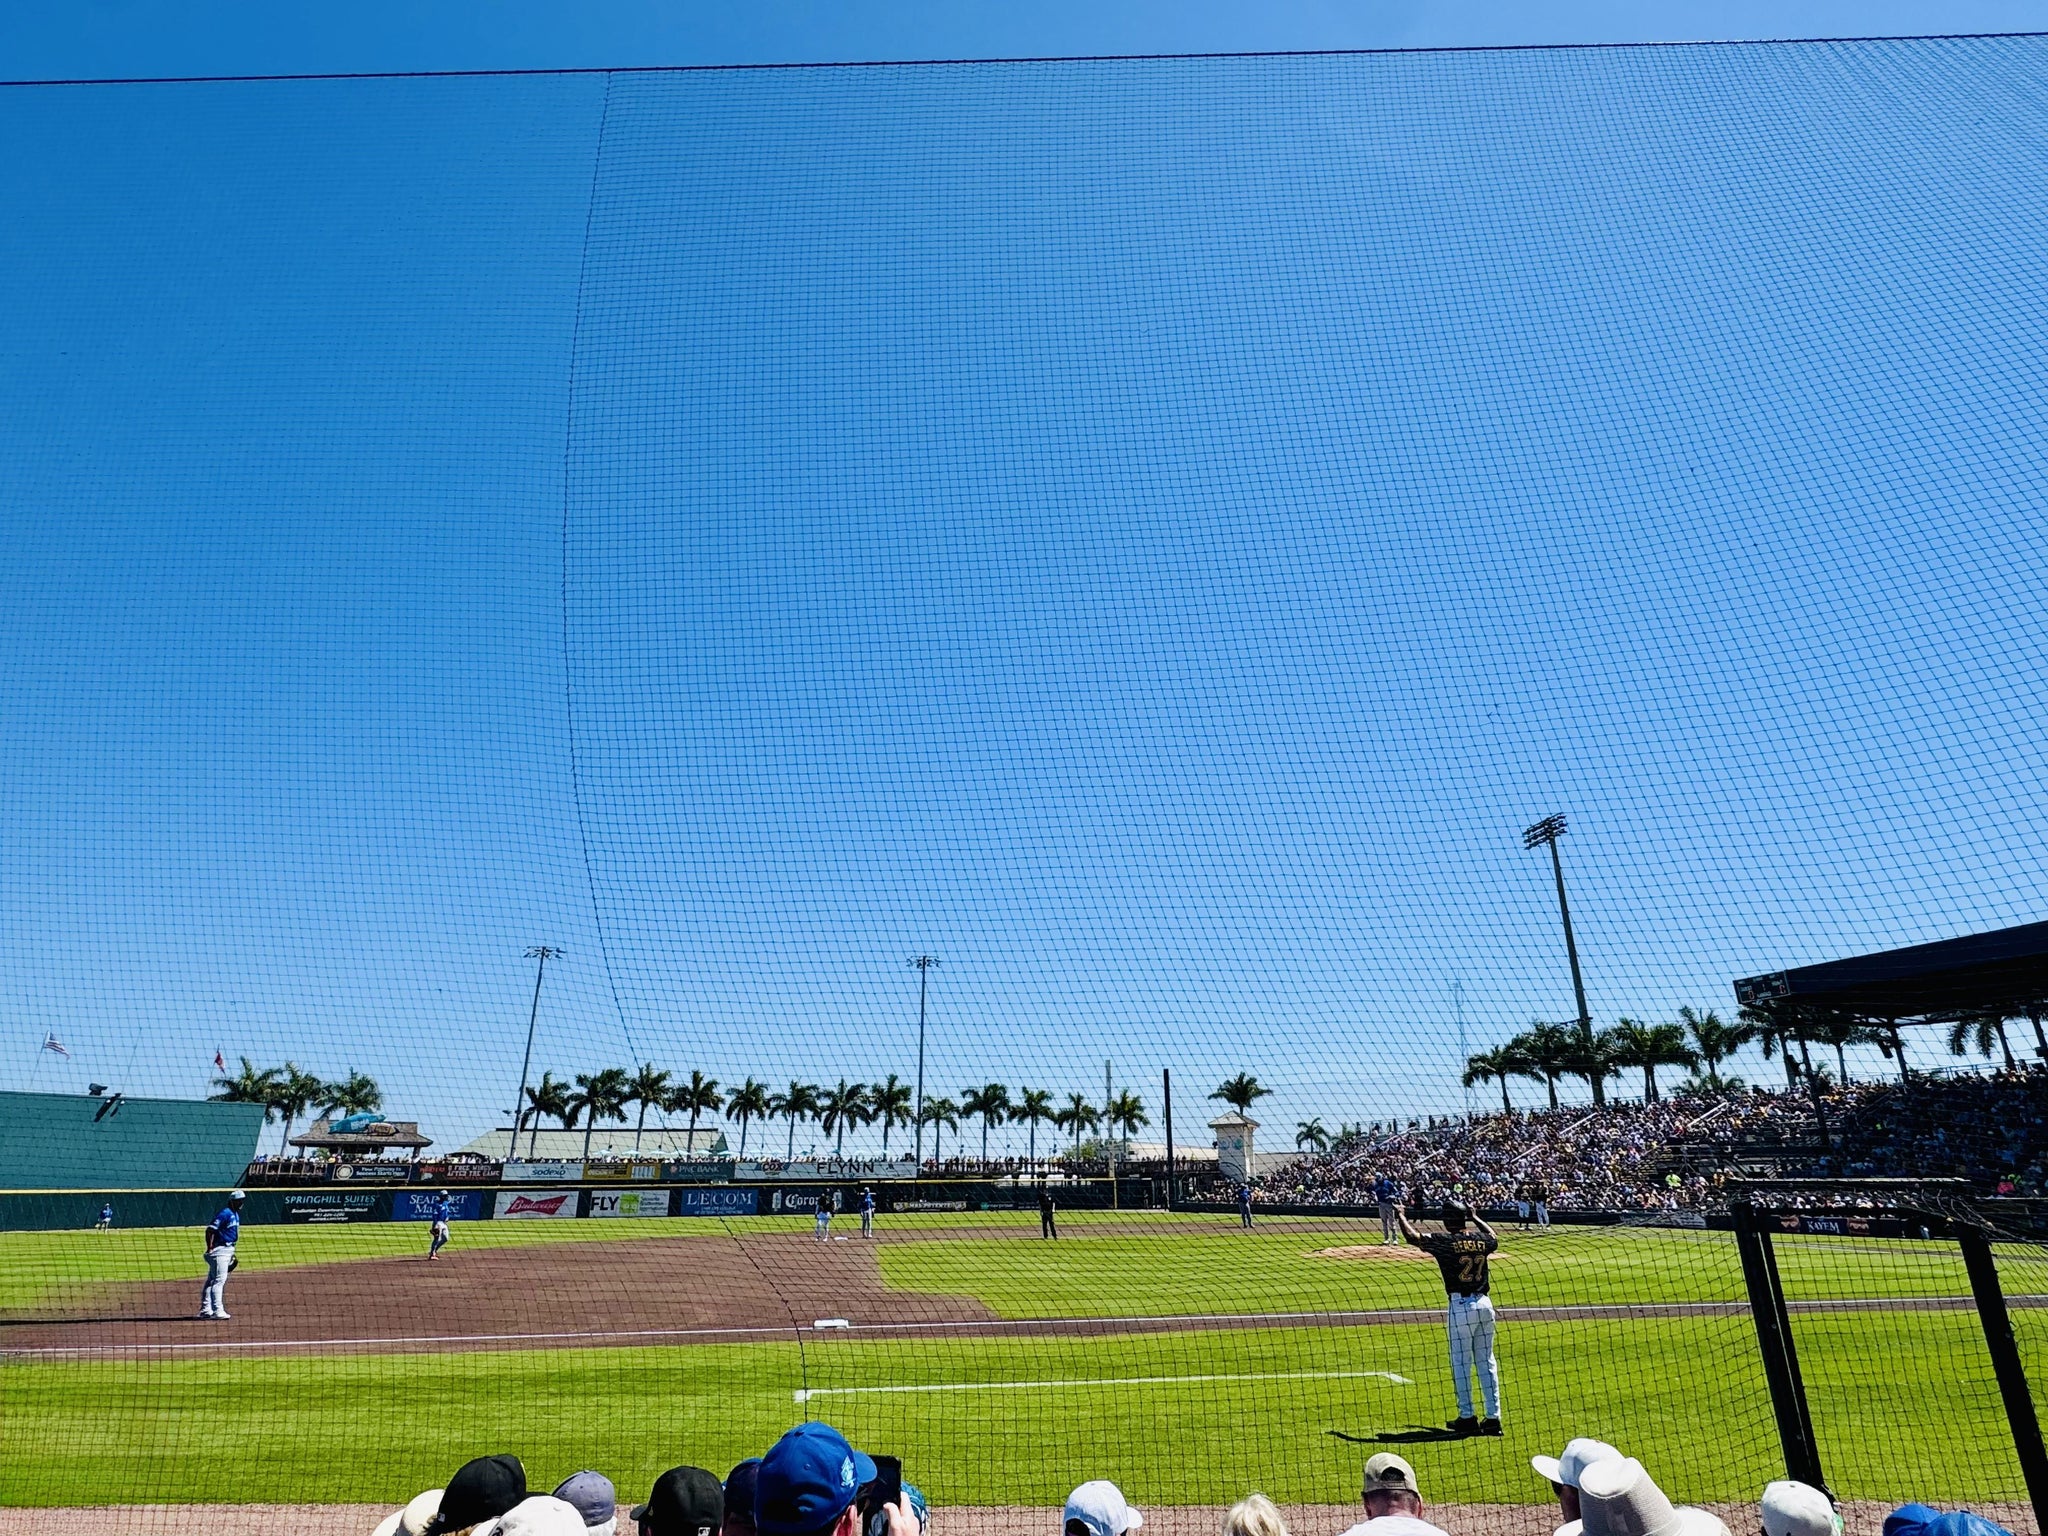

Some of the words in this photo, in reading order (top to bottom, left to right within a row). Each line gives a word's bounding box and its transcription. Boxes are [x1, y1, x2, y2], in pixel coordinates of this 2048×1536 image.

[531, 1164, 566, 1175] sodexo
[816, 1162, 875, 1173] FLYNN
[284, 1195, 342, 1204] SPRINGHILL
[344, 1194, 376, 1203] SUITES
[511, 1199, 562, 1210] Budweiser
[590, 1196, 620, 1211] FLY
[686, 1193, 753, 1205] LECOM
[785, 1194, 820, 1209] Coro
[1806, 1220, 1841, 1233] KAYEM
[1458, 1254, 1486, 1282] 27
